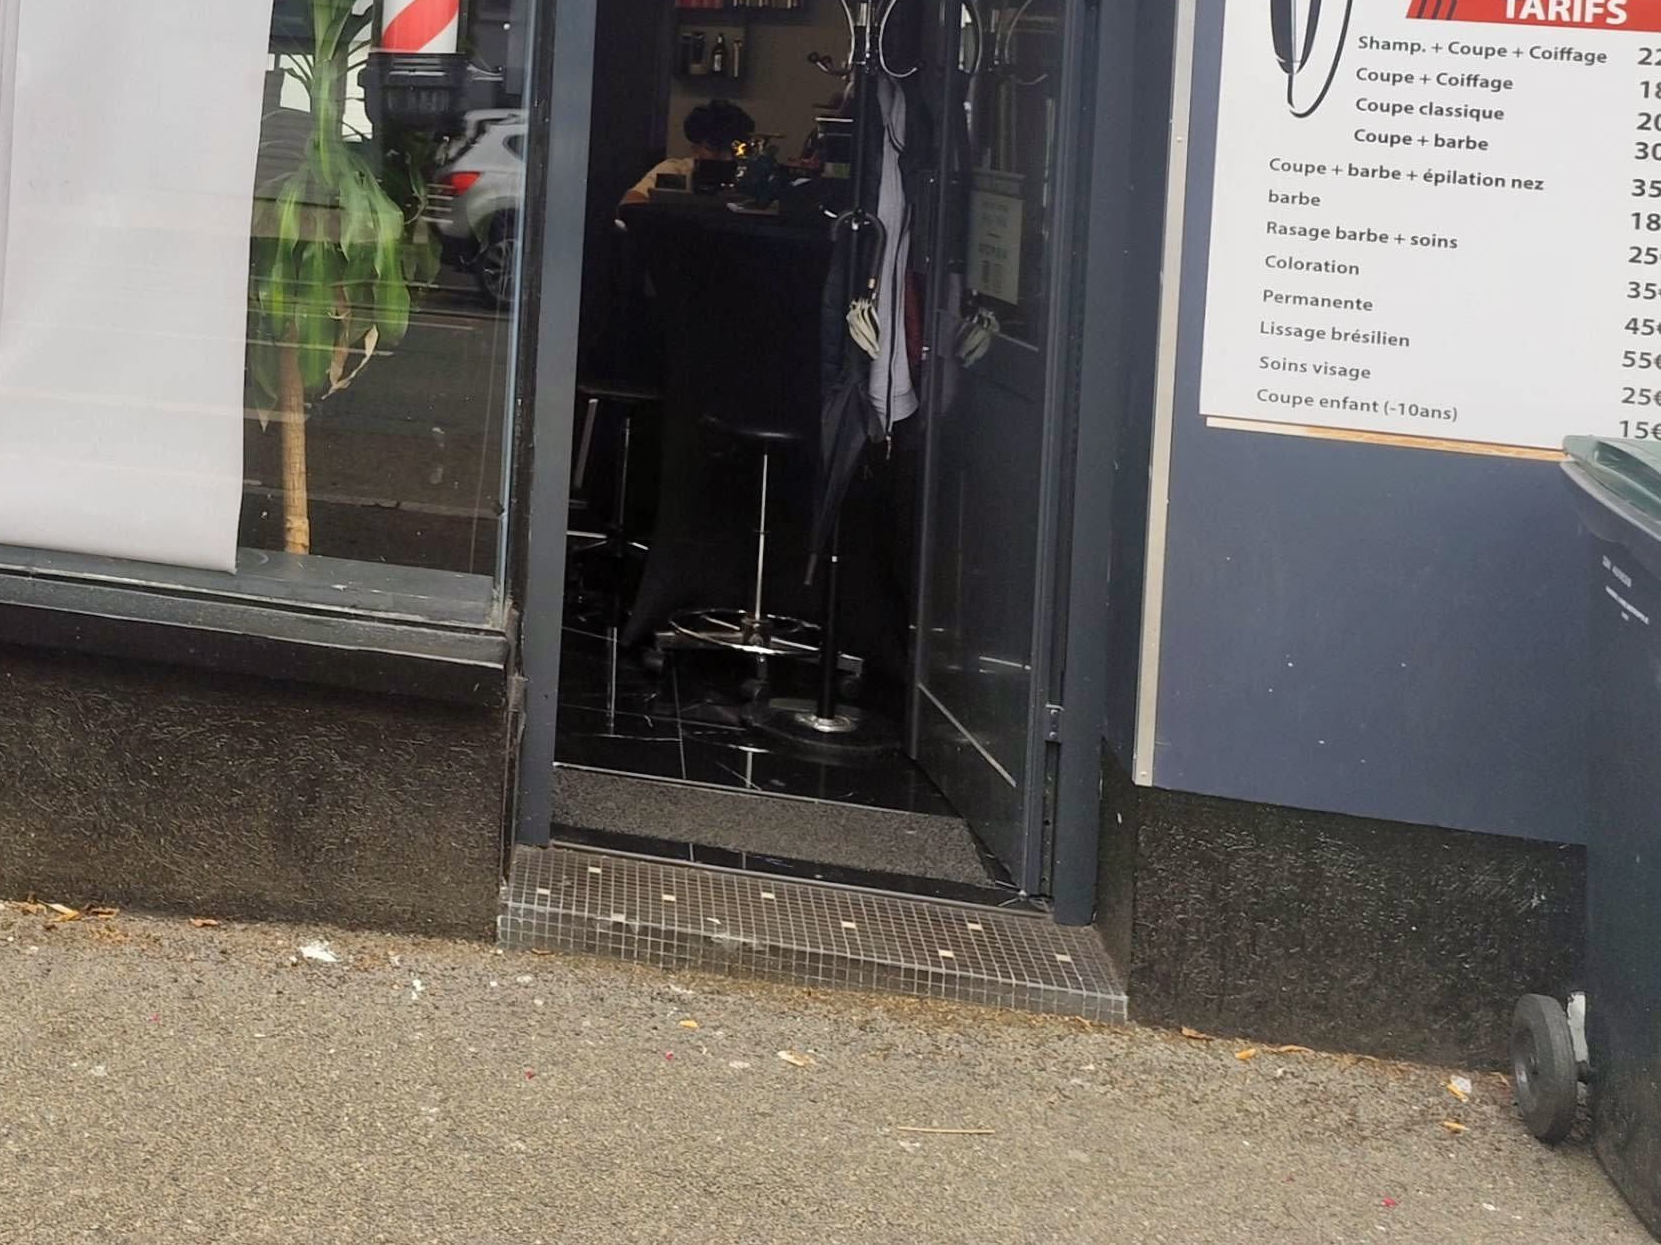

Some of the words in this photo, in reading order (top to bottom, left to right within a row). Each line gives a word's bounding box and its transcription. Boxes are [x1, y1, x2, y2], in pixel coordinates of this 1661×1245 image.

[1358, 35, 1426, 56] Shamp.
[1447, 41, 1508, 60] Coupe
[1529, 45, 1608, 66] Coiffage
[1356, 67, 1415, 87] Coupe
[1436, 72, 1513, 93] Coiffage
[1355, 97, 1415, 117] Coupe
[1418, 101, 1505, 123] classique
[1353, 128, 1413, 148] Coupe
[1434, 133, 1489, 151] barbe
[1269, 157, 1327, 177] Coupe
[1347, 162, 1402, 180] barbe
[1422, 168, 1506, 188] épilation
[1511, 178, 1544, 191] nez
[1268, 189, 1321, 207] barbe
[1266, 221, 1331, 242] Rasage
[1335, 225, 1389, 244] barbe
[1410, 233, 1458, 249] soins
[1265, 255, 1360, 276] Coloration
[1628, 245, 1661, 265] 25
[1263, 289, 1373, 312] Permanente
[1626, 281, 1661, 300] 35
[1260, 321, 1326, 342] Lissage
[1331, 326, 1410, 347] brésilien
[1259, 356, 1308, 373] Soins
[1312, 364, 1371, 381] visage
[1257, 389, 1314, 408] Coupe
[1319, 396, 1379, 413] enfant
[1384, 401, 1458, 422] (-10ans)
